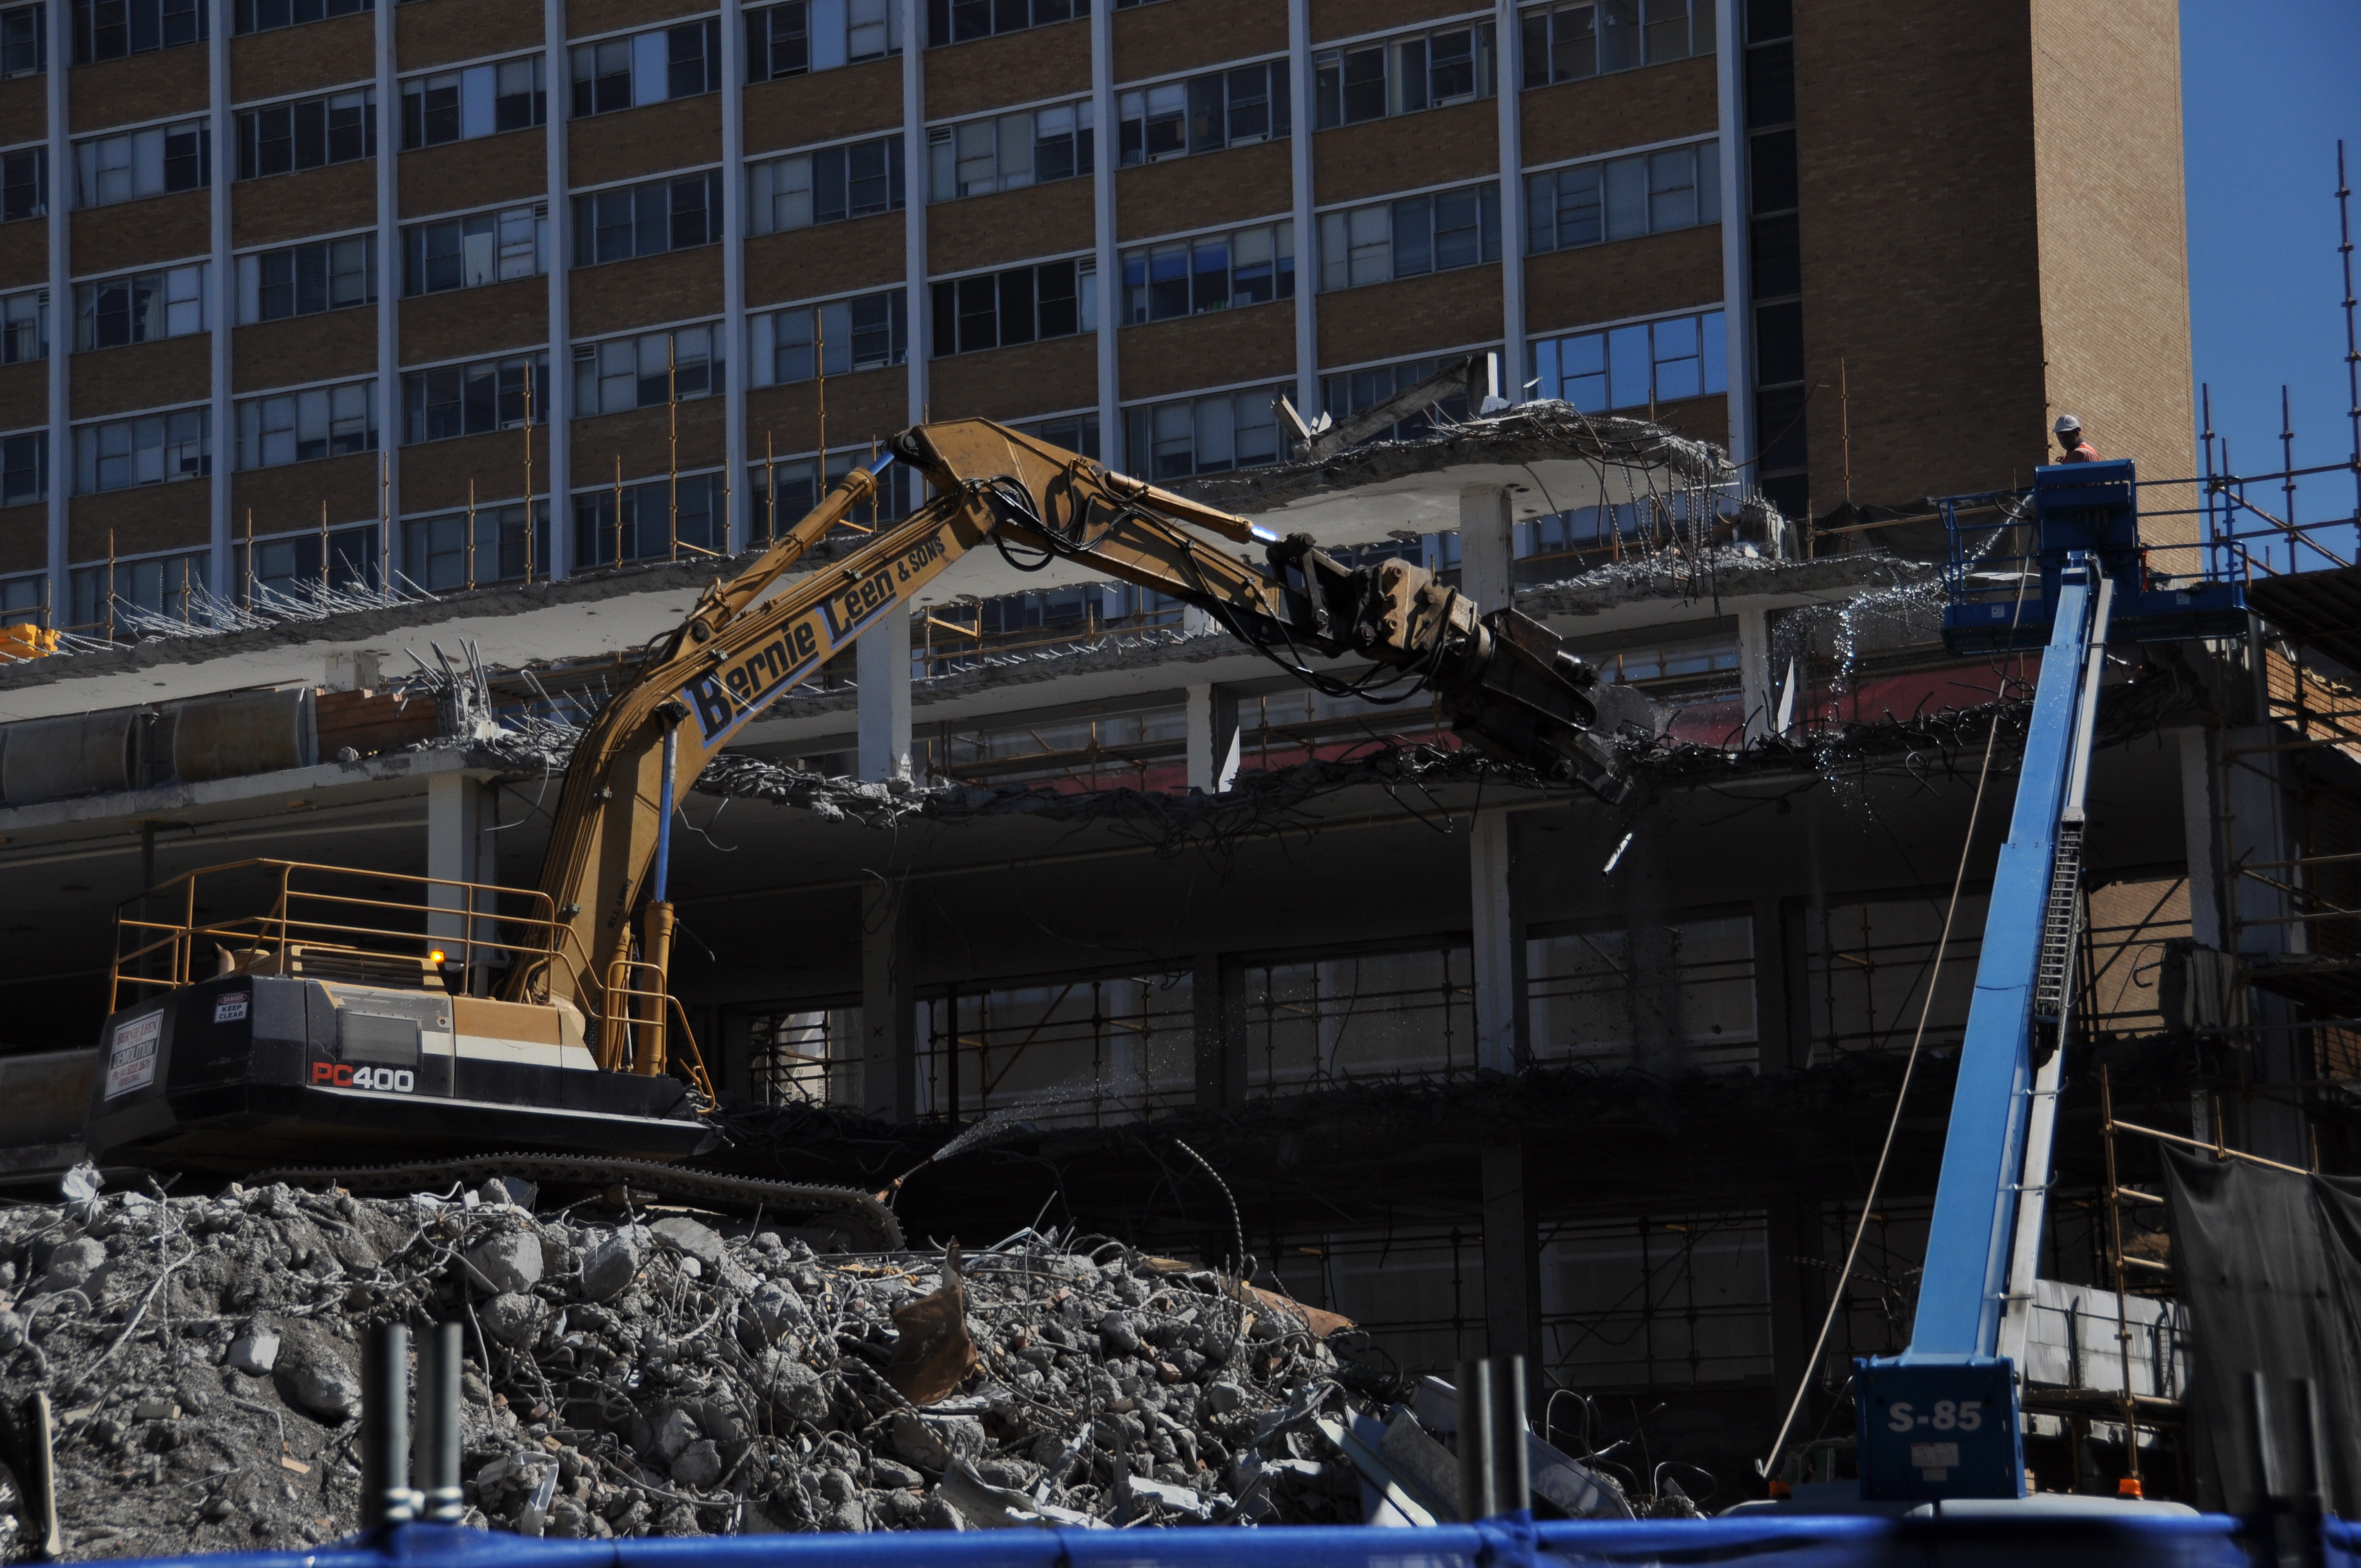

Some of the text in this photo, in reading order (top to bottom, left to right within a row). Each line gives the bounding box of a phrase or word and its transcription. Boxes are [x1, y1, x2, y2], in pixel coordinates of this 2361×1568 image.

[682, 535, 946, 744] Bernie Leen & SONS
[219, 1011, 243, 1020] CLEAR
[222, 1004, 242, 1012] KEEP
[117, 1026, 140, 1045] BERNIE
[140, 1021, 157, 1036] LEEN
[113, 1039, 154, 1068] DEMOLITION
[118, 1072, 141, 1087] GEELONG
[312, 1061, 414, 1092] PC400
[1887, 1400, 1982, 1432] S-85
